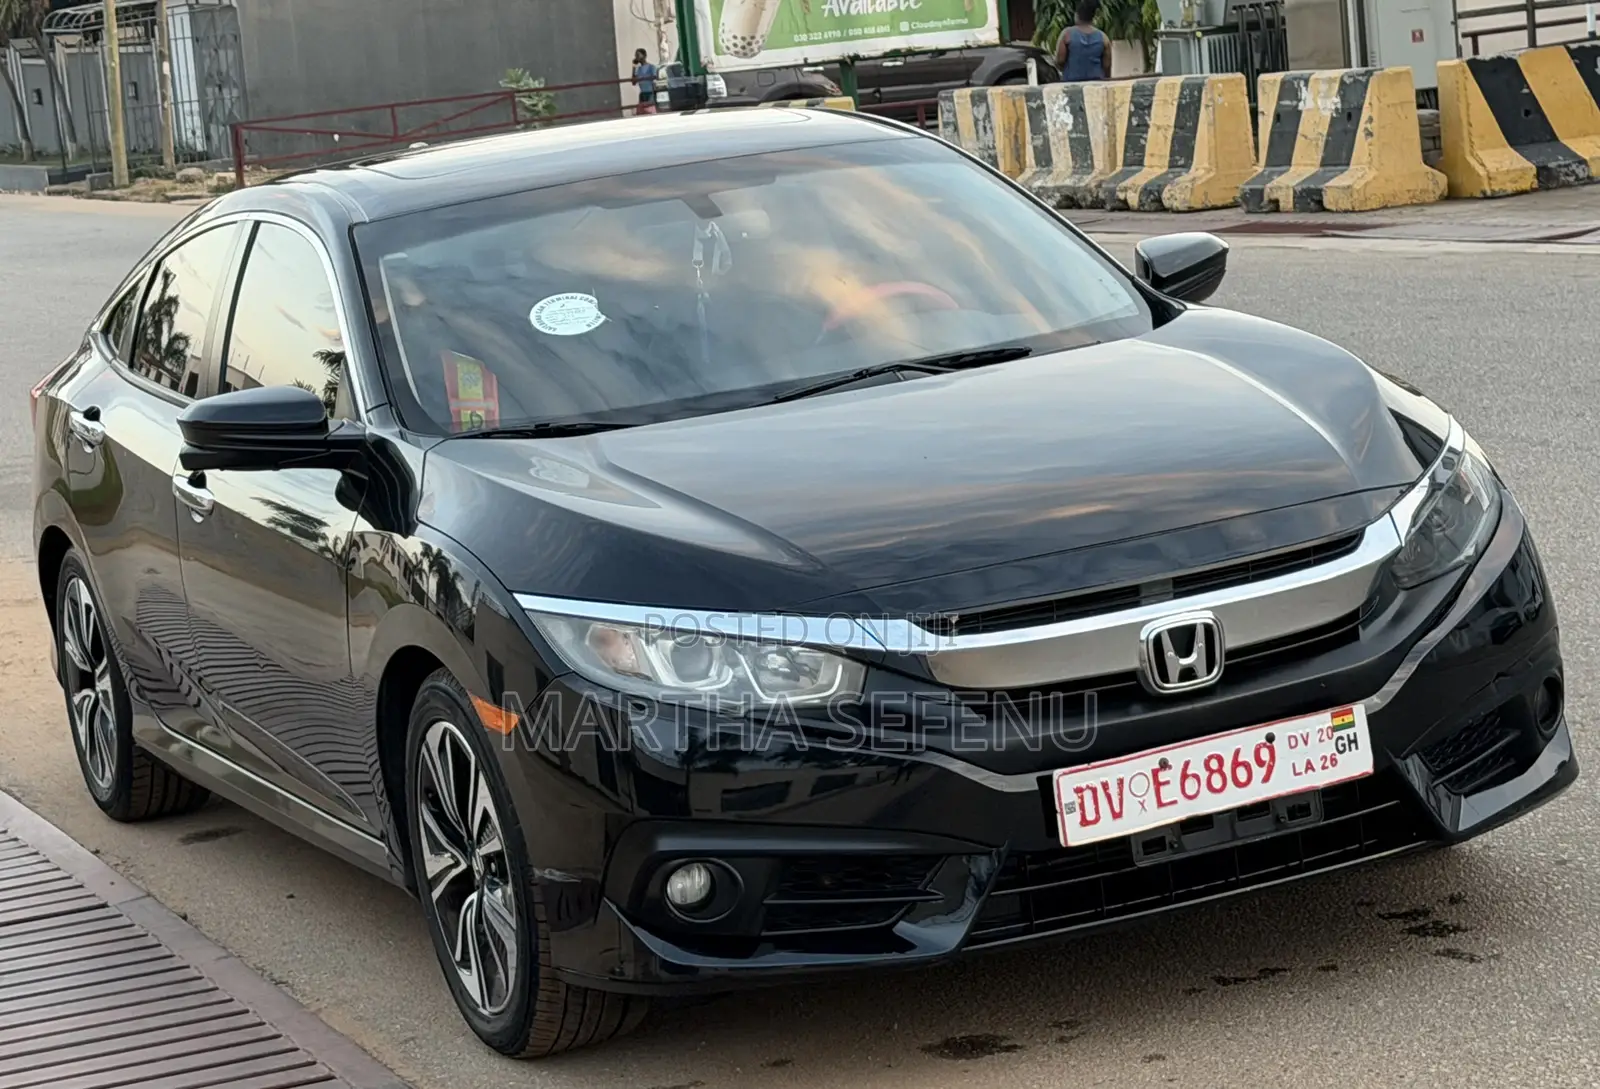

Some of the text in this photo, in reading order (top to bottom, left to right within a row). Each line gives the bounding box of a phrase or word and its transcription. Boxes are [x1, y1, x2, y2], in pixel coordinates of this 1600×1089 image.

[1288, 725, 1334, 750] DV 20
[1335, 731, 1360, 755] GH
[1291, 753, 1338, 776] LA 26
[1073, 740, 1276, 828] DV E6869
